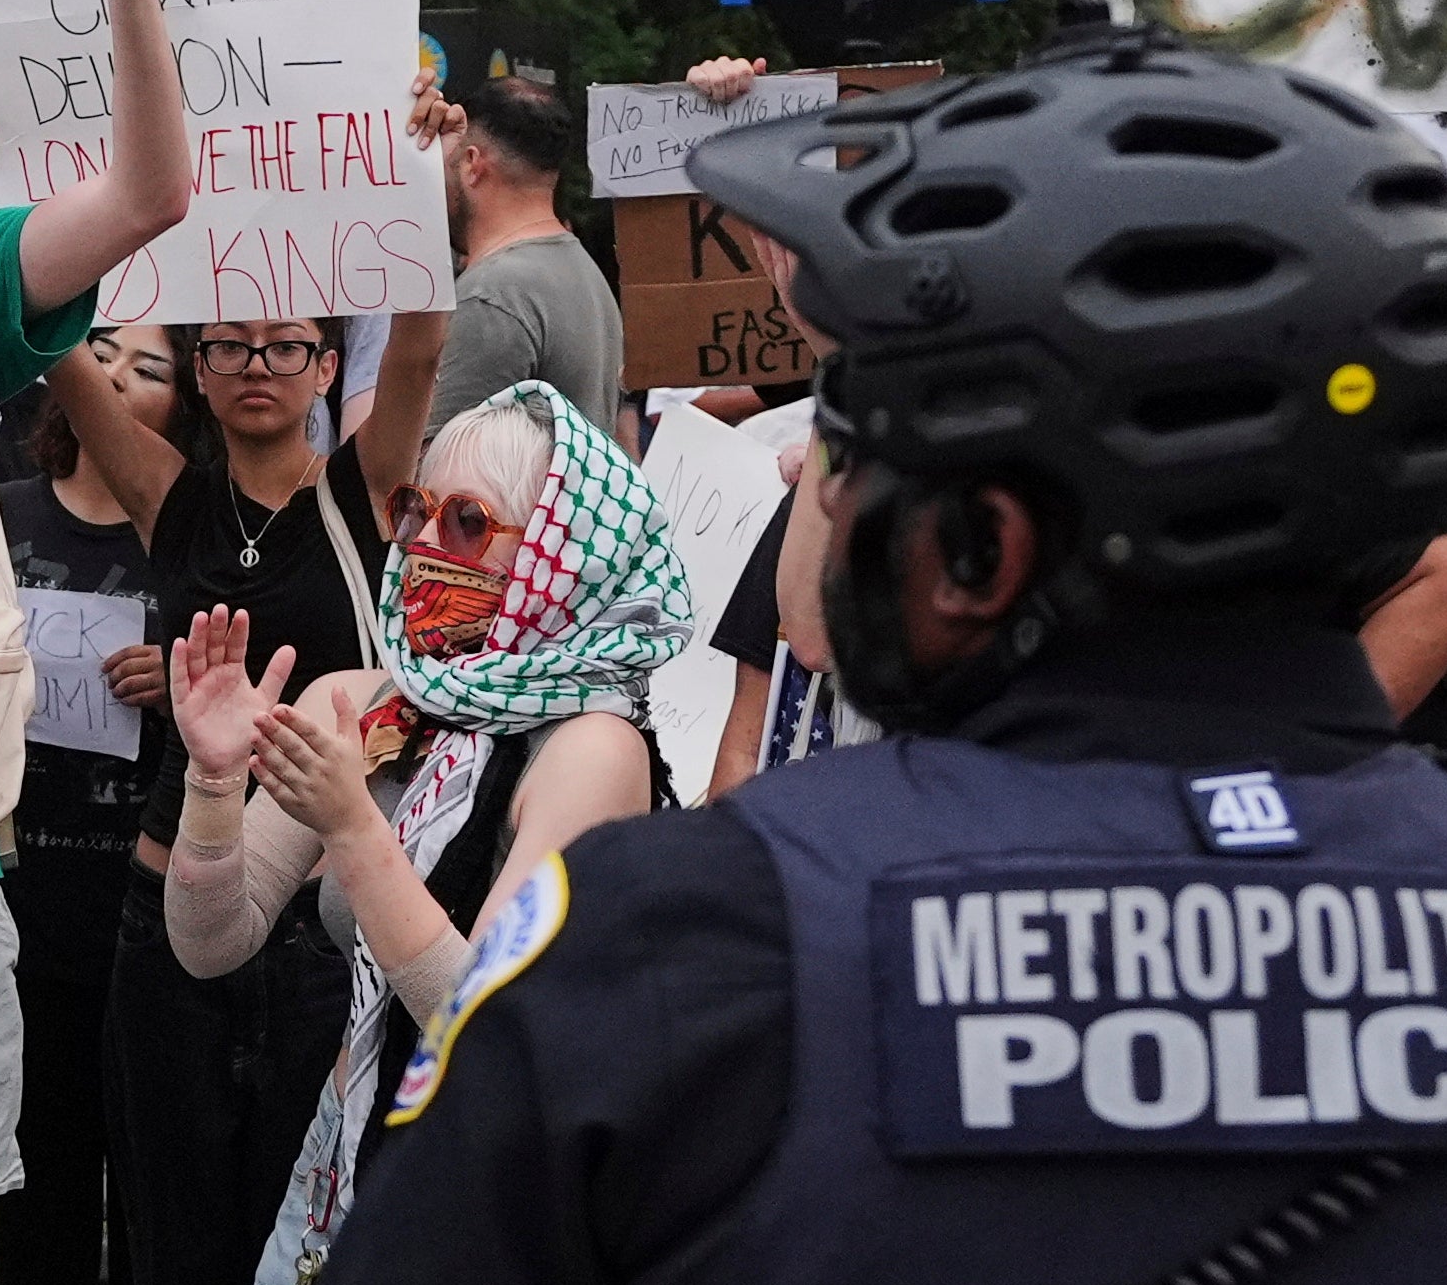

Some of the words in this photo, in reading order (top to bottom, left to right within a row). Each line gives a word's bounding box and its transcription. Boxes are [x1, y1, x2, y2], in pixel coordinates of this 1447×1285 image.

[603, 96, 642, 135] NO
[241, 118, 298, 194] THE
[317, 108, 408, 189] FALL
[610, 145, 642, 175] NO
[208, 220, 435, 322] KINGS
